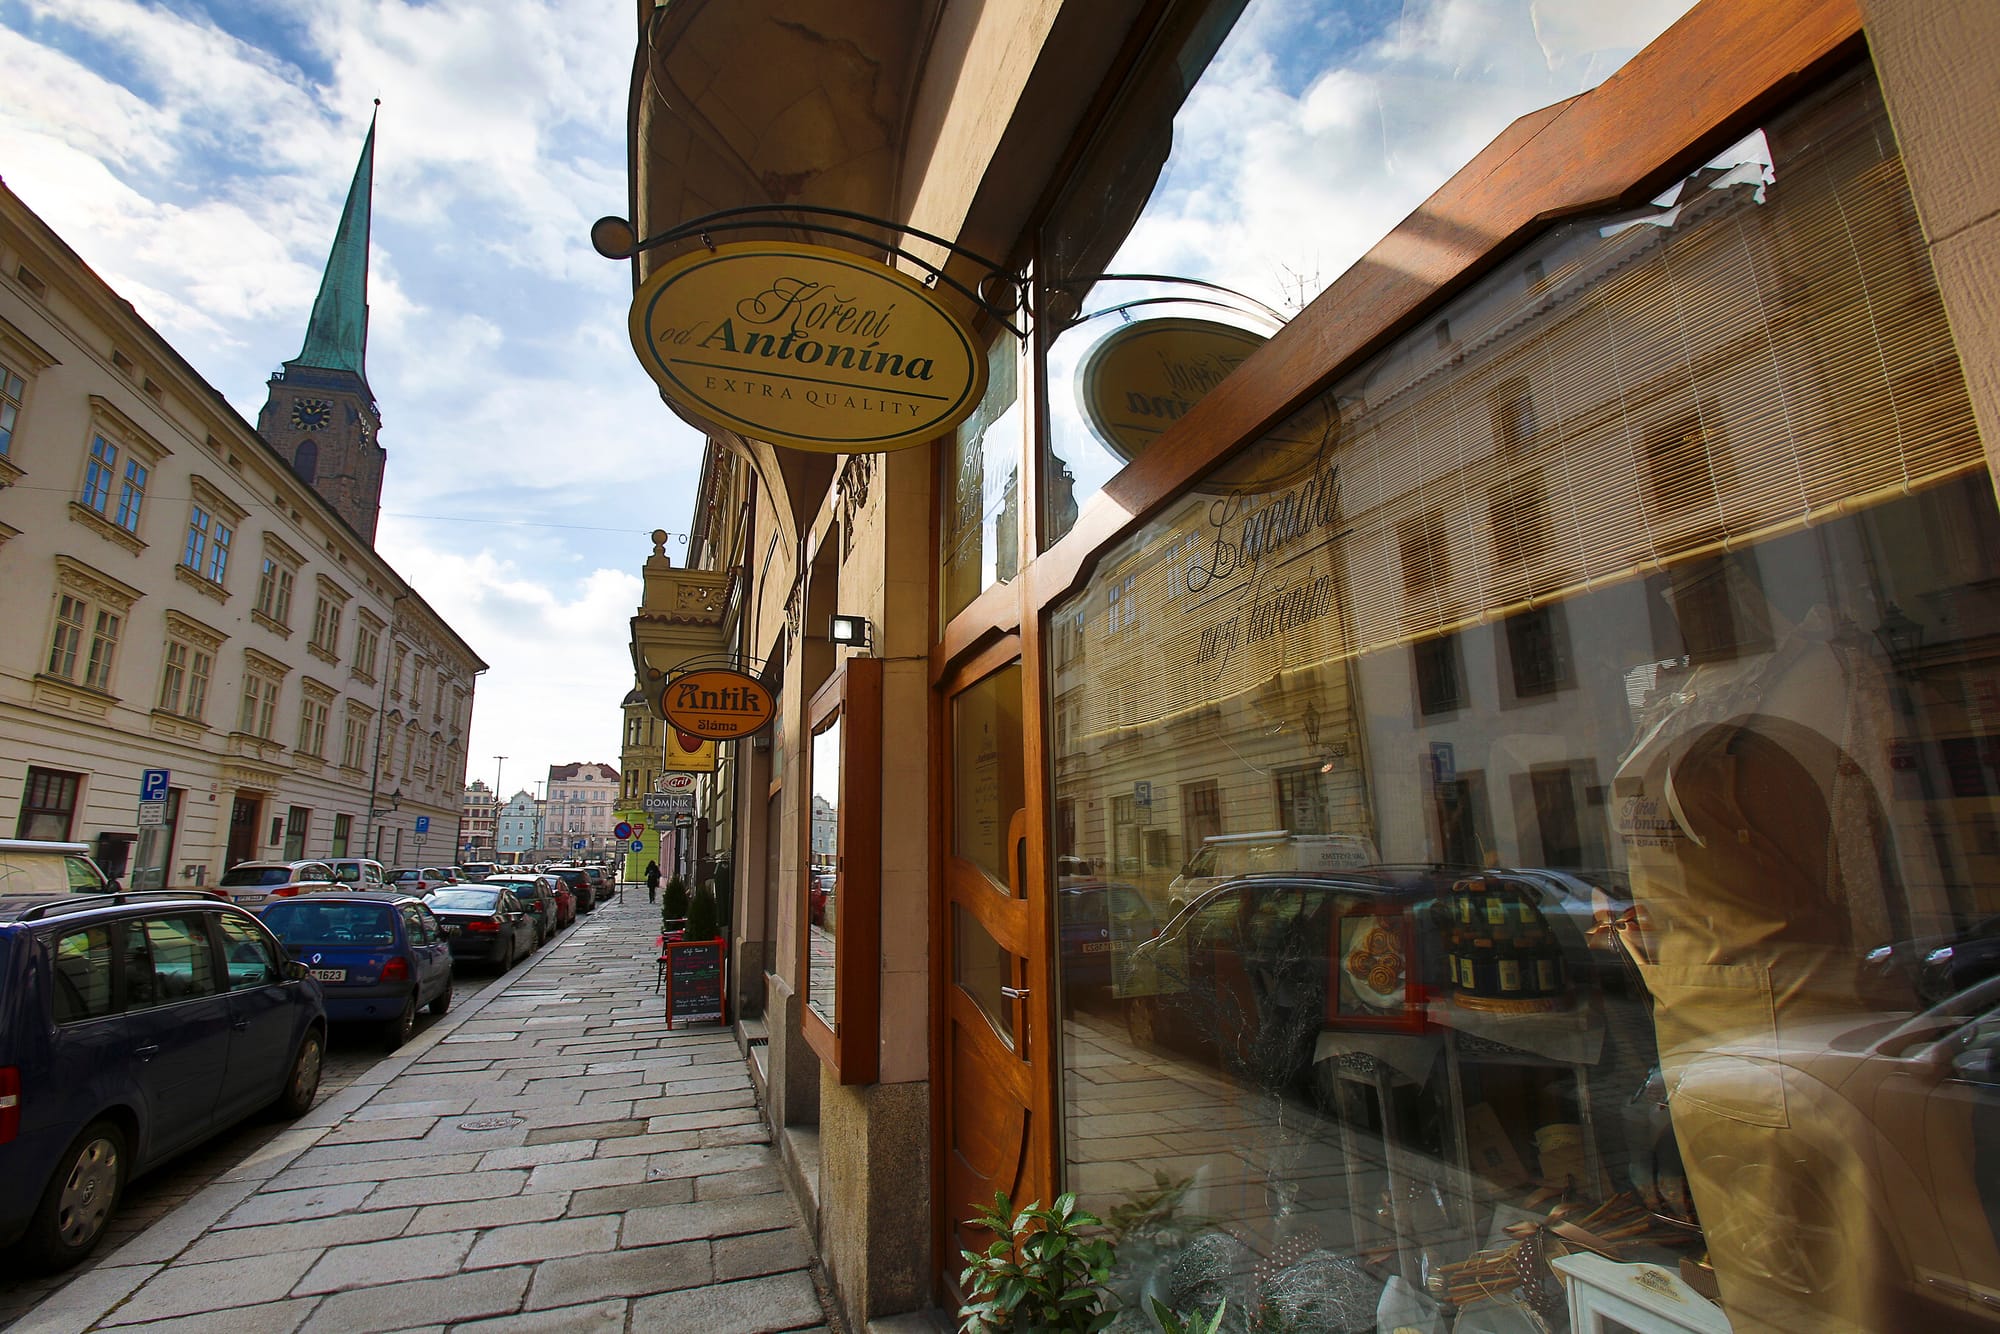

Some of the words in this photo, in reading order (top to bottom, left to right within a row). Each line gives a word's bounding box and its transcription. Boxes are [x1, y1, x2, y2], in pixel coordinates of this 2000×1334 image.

[736, 277, 896, 340] Koření
[659, 320, 709, 345] od
[696, 317, 934, 381] Antonína
[705, 376, 793, 400] EXTRA
[806, 390, 921, 417] QUALITY
[1187, 417, 1341, 602] Legenda
[677, 683, 760, 712] Antik
[697, 719, 738, 731] Sláma
[147, 773, 164, 792] P
[646, 799, 688, 808] DOMINIK
[419, 818, 427, 828] P
[318, 970, 342, 981] 1623
